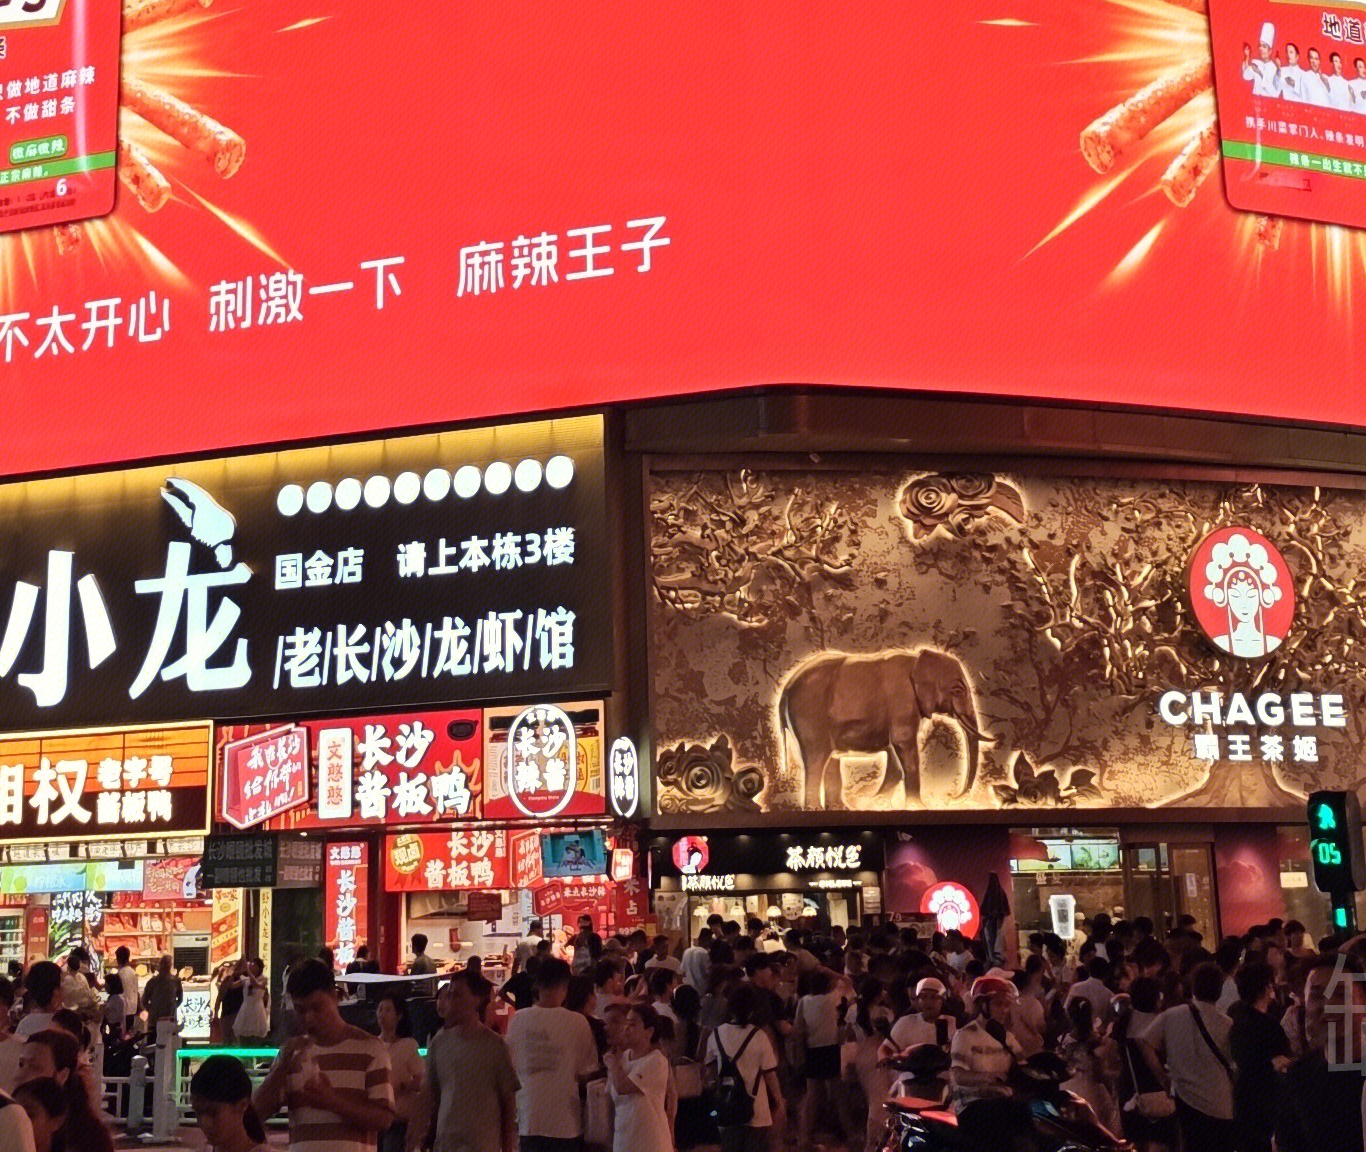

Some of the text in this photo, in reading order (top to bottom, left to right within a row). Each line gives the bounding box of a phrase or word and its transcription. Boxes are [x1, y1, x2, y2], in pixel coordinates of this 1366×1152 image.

[5, 96, 76, 125] 不做甜条
[208, 257, 407, 335] 刺激一下
[455, 216, 672, 299] 麻辣王子
[273, 526, 577, 591] 国金店 请上本栋3楼
[1159, 690, 1347, 728] CHAGEE
[357, 720, 435, 771] 长沙
[515, 724, 567, 759] 长沙
[1194, 734, 1319, 763] 霸王茶姬
[97, 754, 174, 789] 老字号
[326, 740, 344, 806] 文憨憨
[355, 764, 472, 818] 酱板鸭
[447, 830, 495, 859] 长沙
[785, 844, 863, 872] 茶颜悦色
[1318, 842, 1342, 866] 05
[423, 856, 496, 890] 酱板鸭
